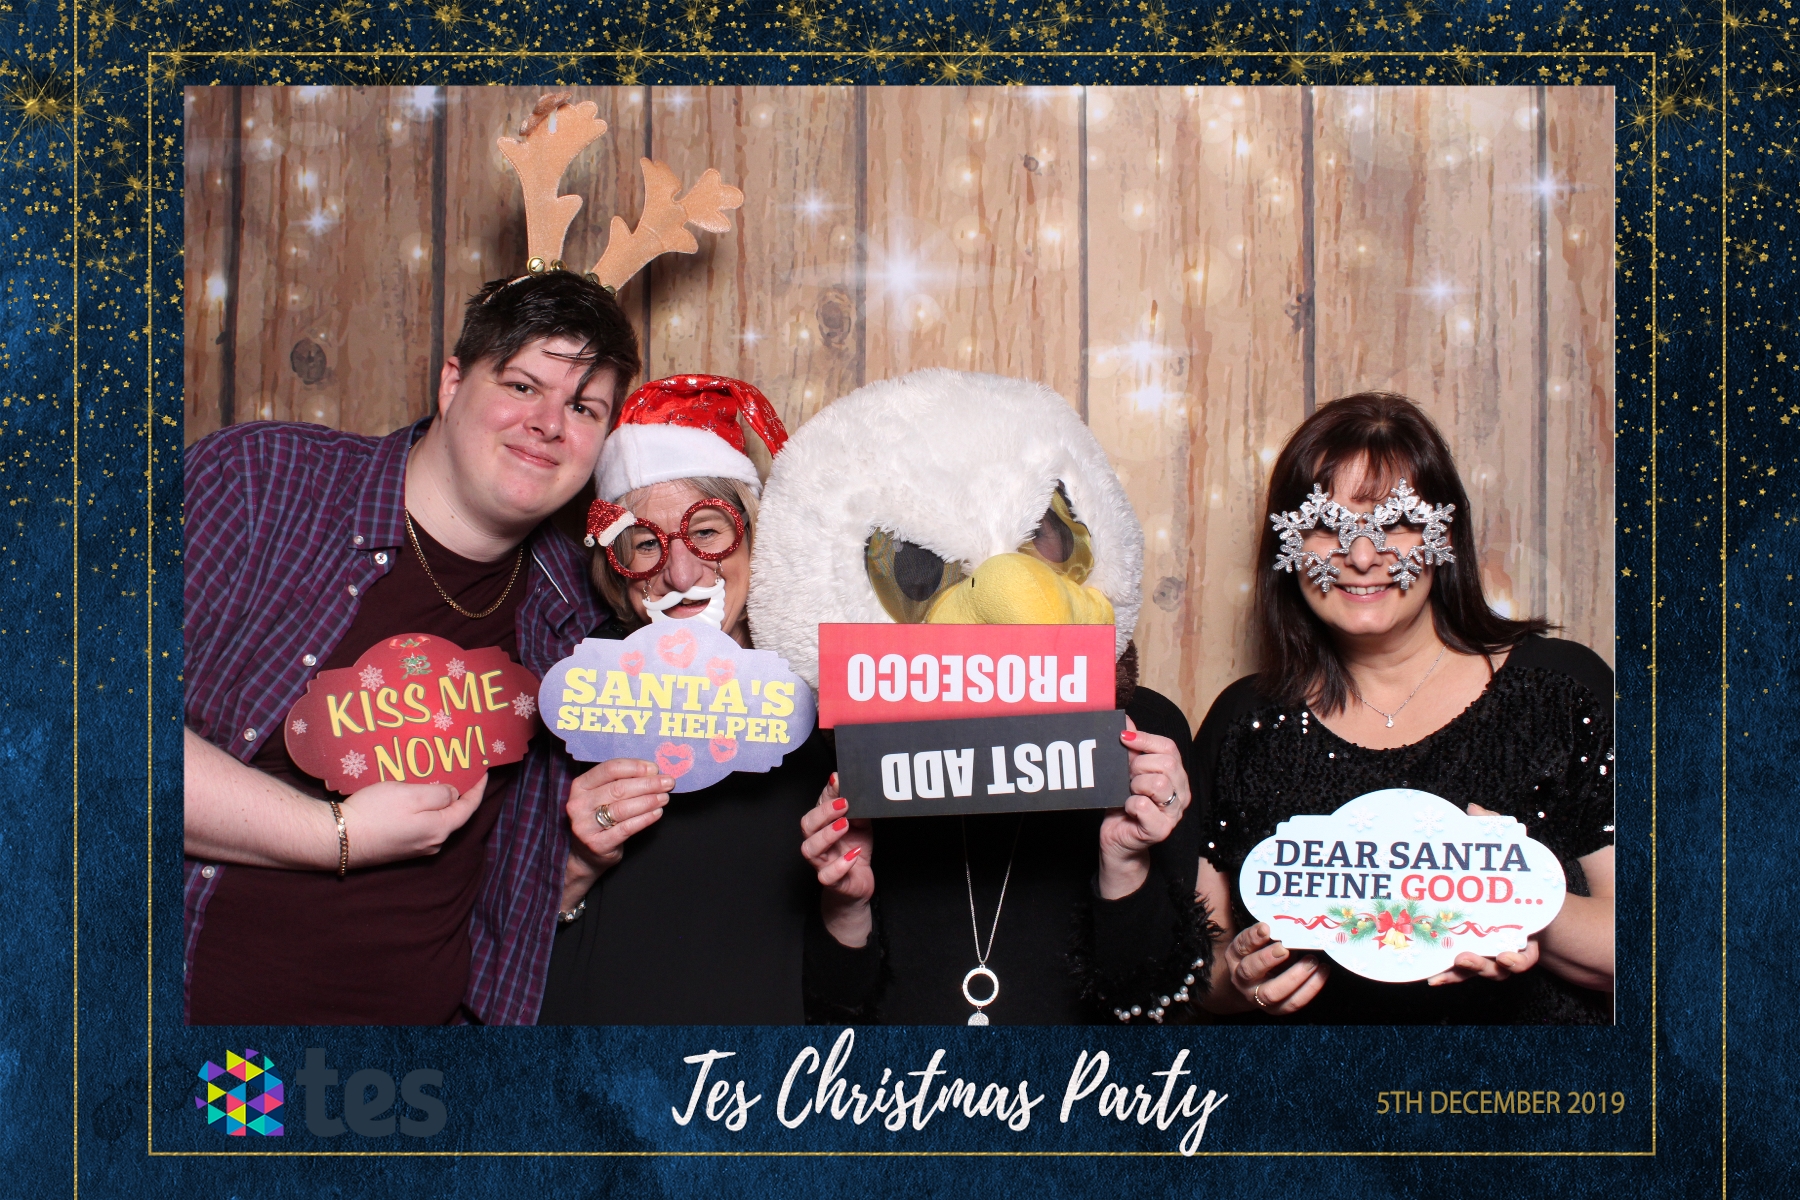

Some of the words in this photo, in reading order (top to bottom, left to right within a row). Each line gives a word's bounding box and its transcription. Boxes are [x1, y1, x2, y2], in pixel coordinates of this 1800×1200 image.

[562, 667, 796, 717] SANTA'S
[847, 653, 1088, 703] PROSECCO
[326, 682, 431, 738] KISS
[439, 669, 509, 714] ME
[557, 705, 653, 736] SEXY
[658, 709, 791, 744] HELPER
[373, 725, 489, 783] NOW!
[880, 748, 975, 801] ADD
[986, 739, 1097, 795] JUST
[1273, 839, 1378, 869] DEAR
[1388, 841, 1531, 872] SANTA
[1256, 870, 1392, 900] DEFINE
[1400, 874, 1544, 905] GOOD...
